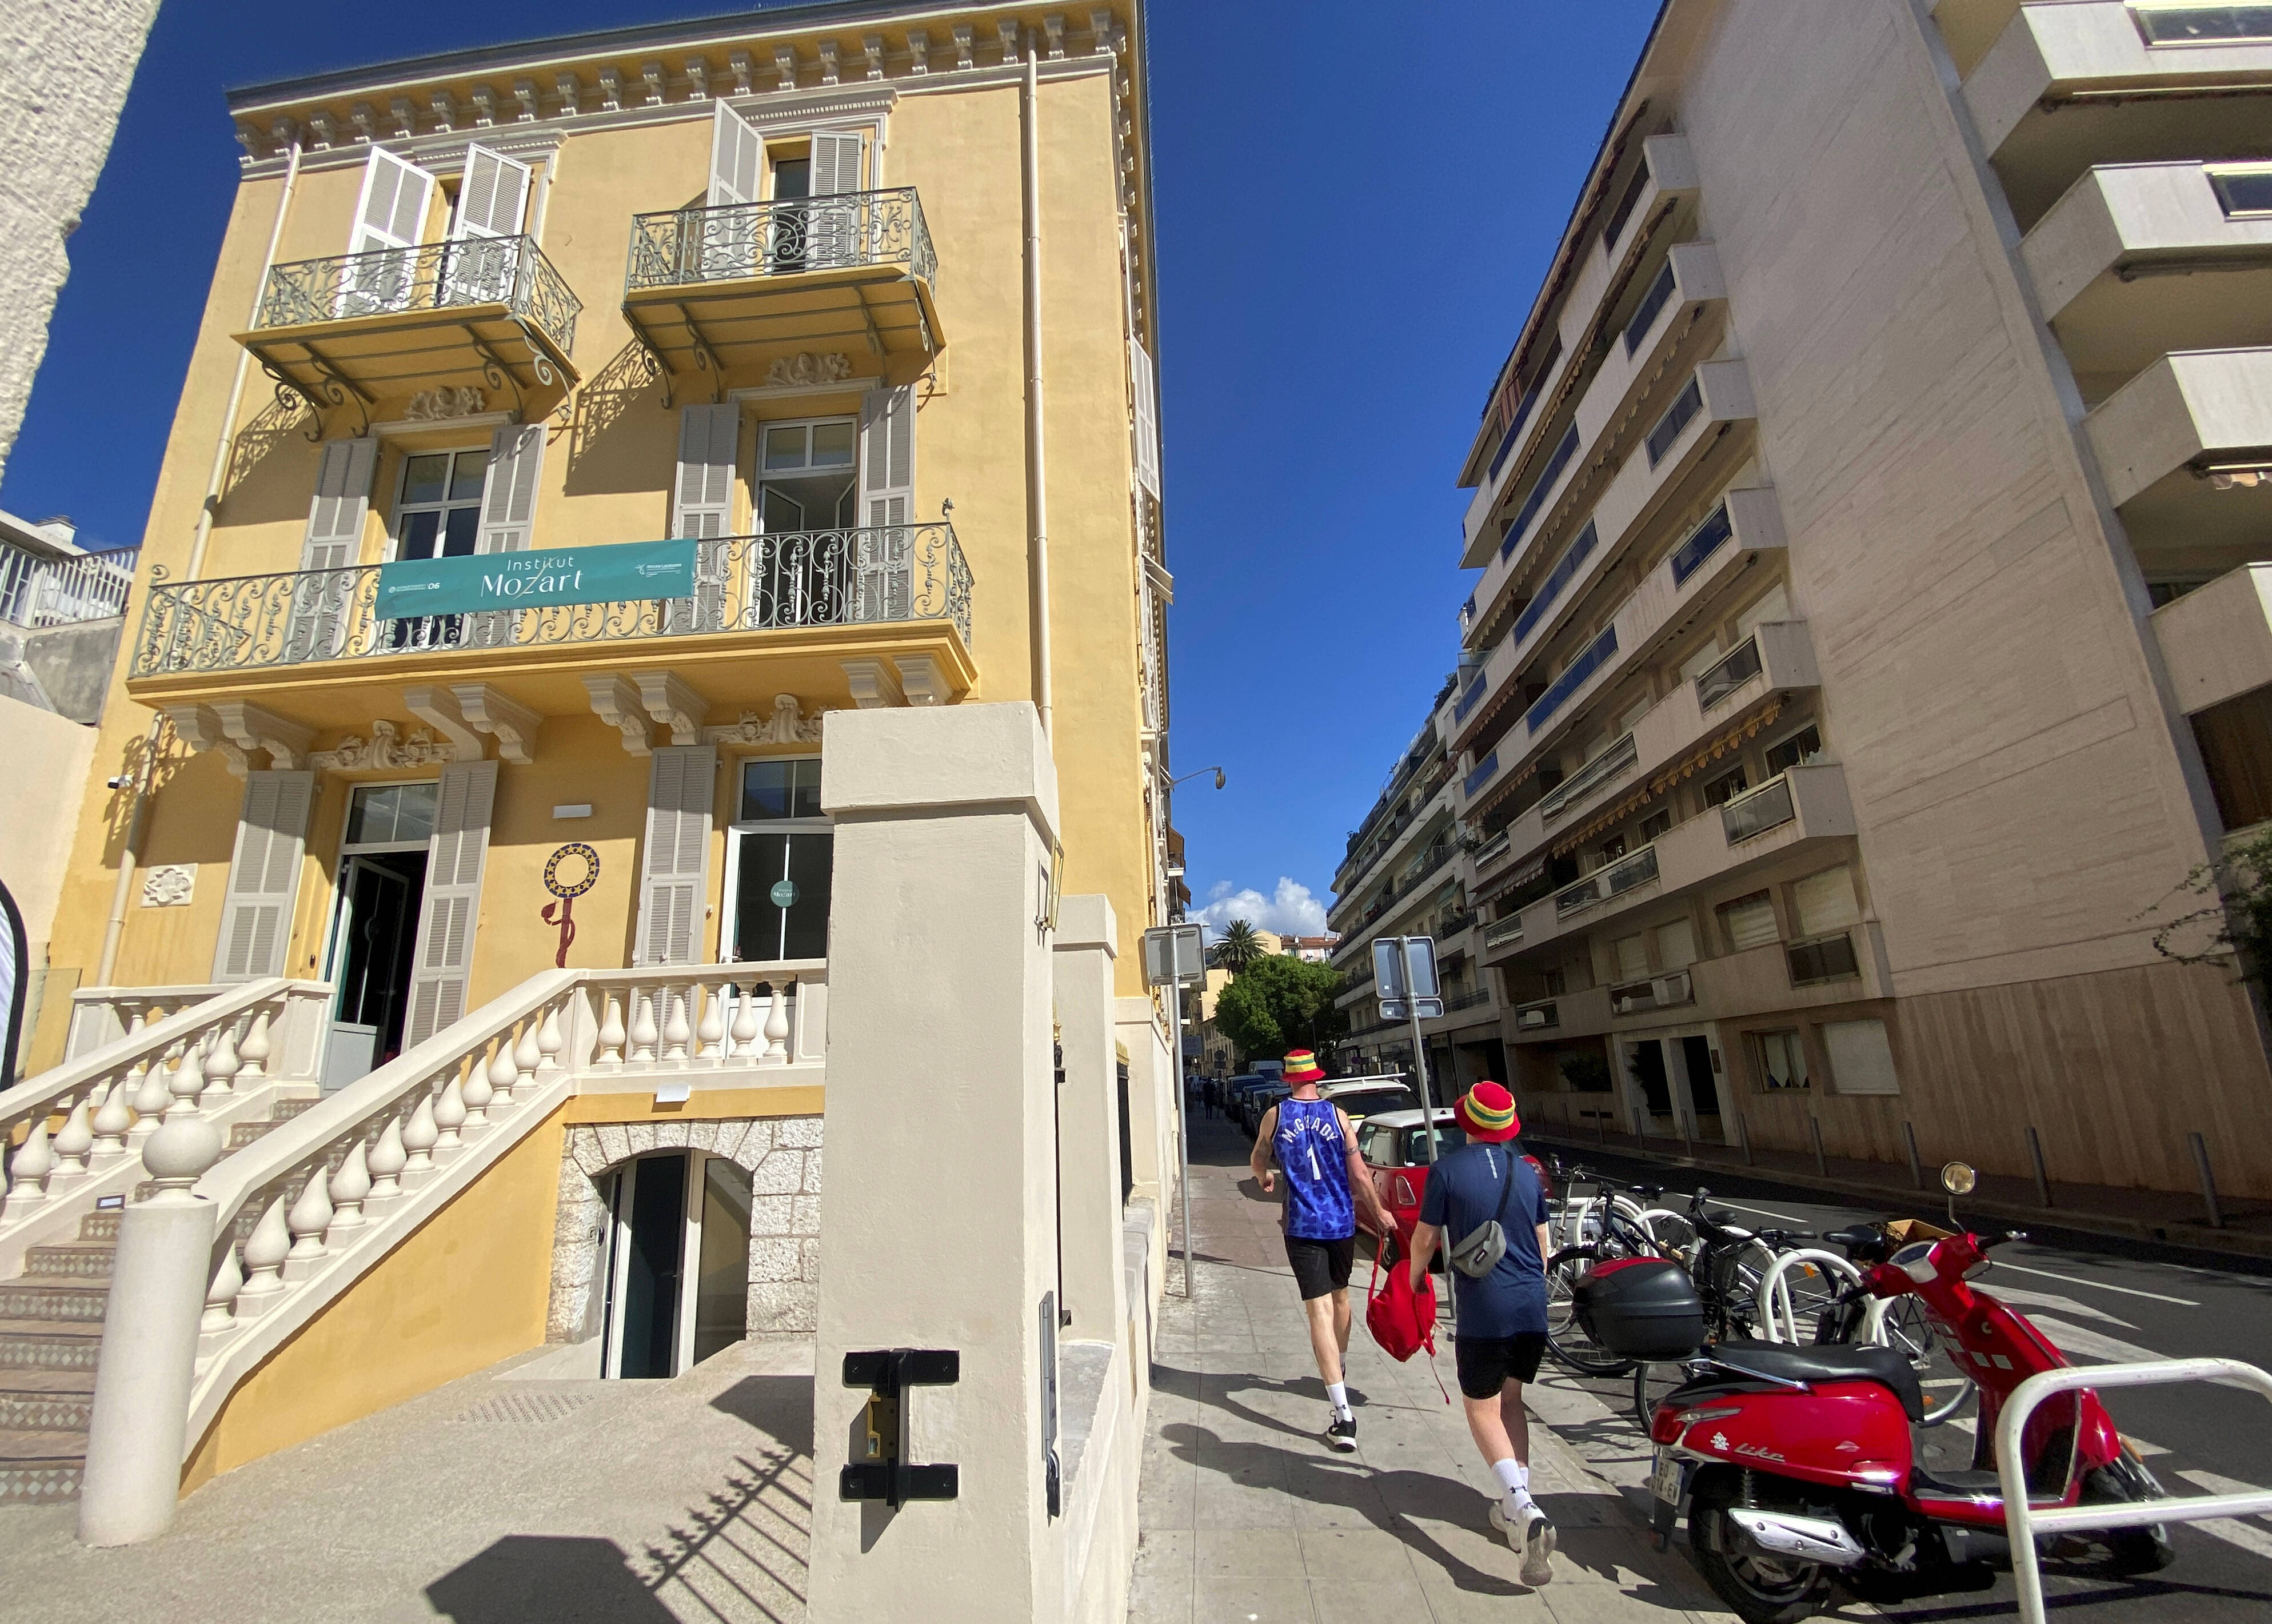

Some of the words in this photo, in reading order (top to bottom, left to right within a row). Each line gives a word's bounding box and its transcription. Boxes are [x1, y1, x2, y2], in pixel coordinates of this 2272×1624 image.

[507, 556, 574, 572] Institut
[428, 582, 441, 590] 06
[480, 570, 584, 598] Mozart
[1307, 1143, 1321, 1180] 1
[1733, 1442, 1786, 1462] Like
